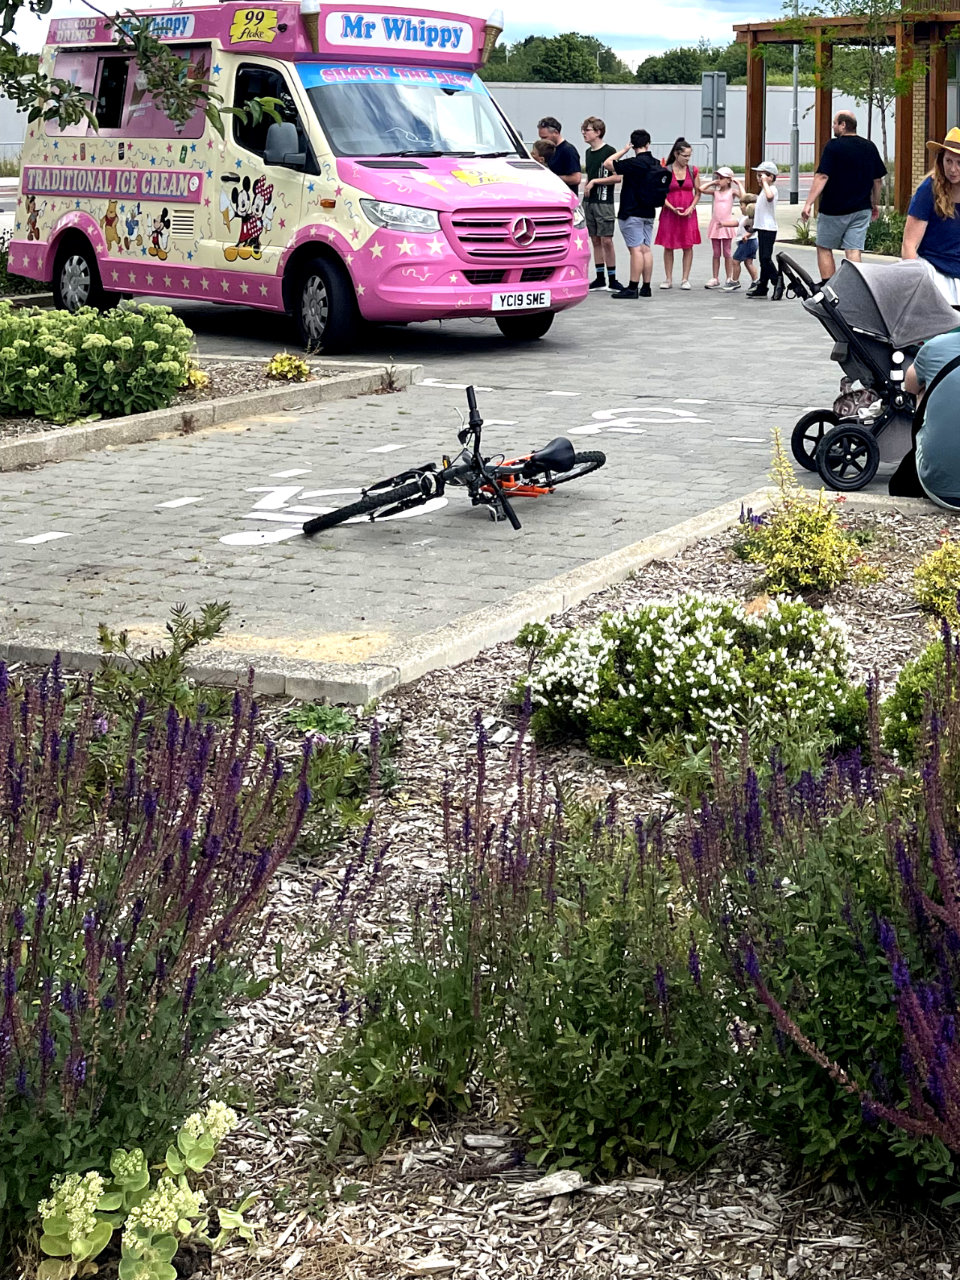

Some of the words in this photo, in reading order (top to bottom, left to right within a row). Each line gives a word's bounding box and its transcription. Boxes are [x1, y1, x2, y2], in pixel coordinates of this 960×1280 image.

[244, 10, 265, 26] 99
[56, 29, 96, 42] DRINKS
[341, 13, 376, 40] Mr
[382, 17, 464, 49] Whippy
[320, 67, 390, 83] SIMPLY
[393, 67, 432, 83] THE
[27, 169, 112, 193] TRADITIONAL
[115, 172, 138, 194] ICE
[141, 173, 189, 197] CREAM
[500, 293, 523, 307] YC19
[526, 292, 546, 306] SME
